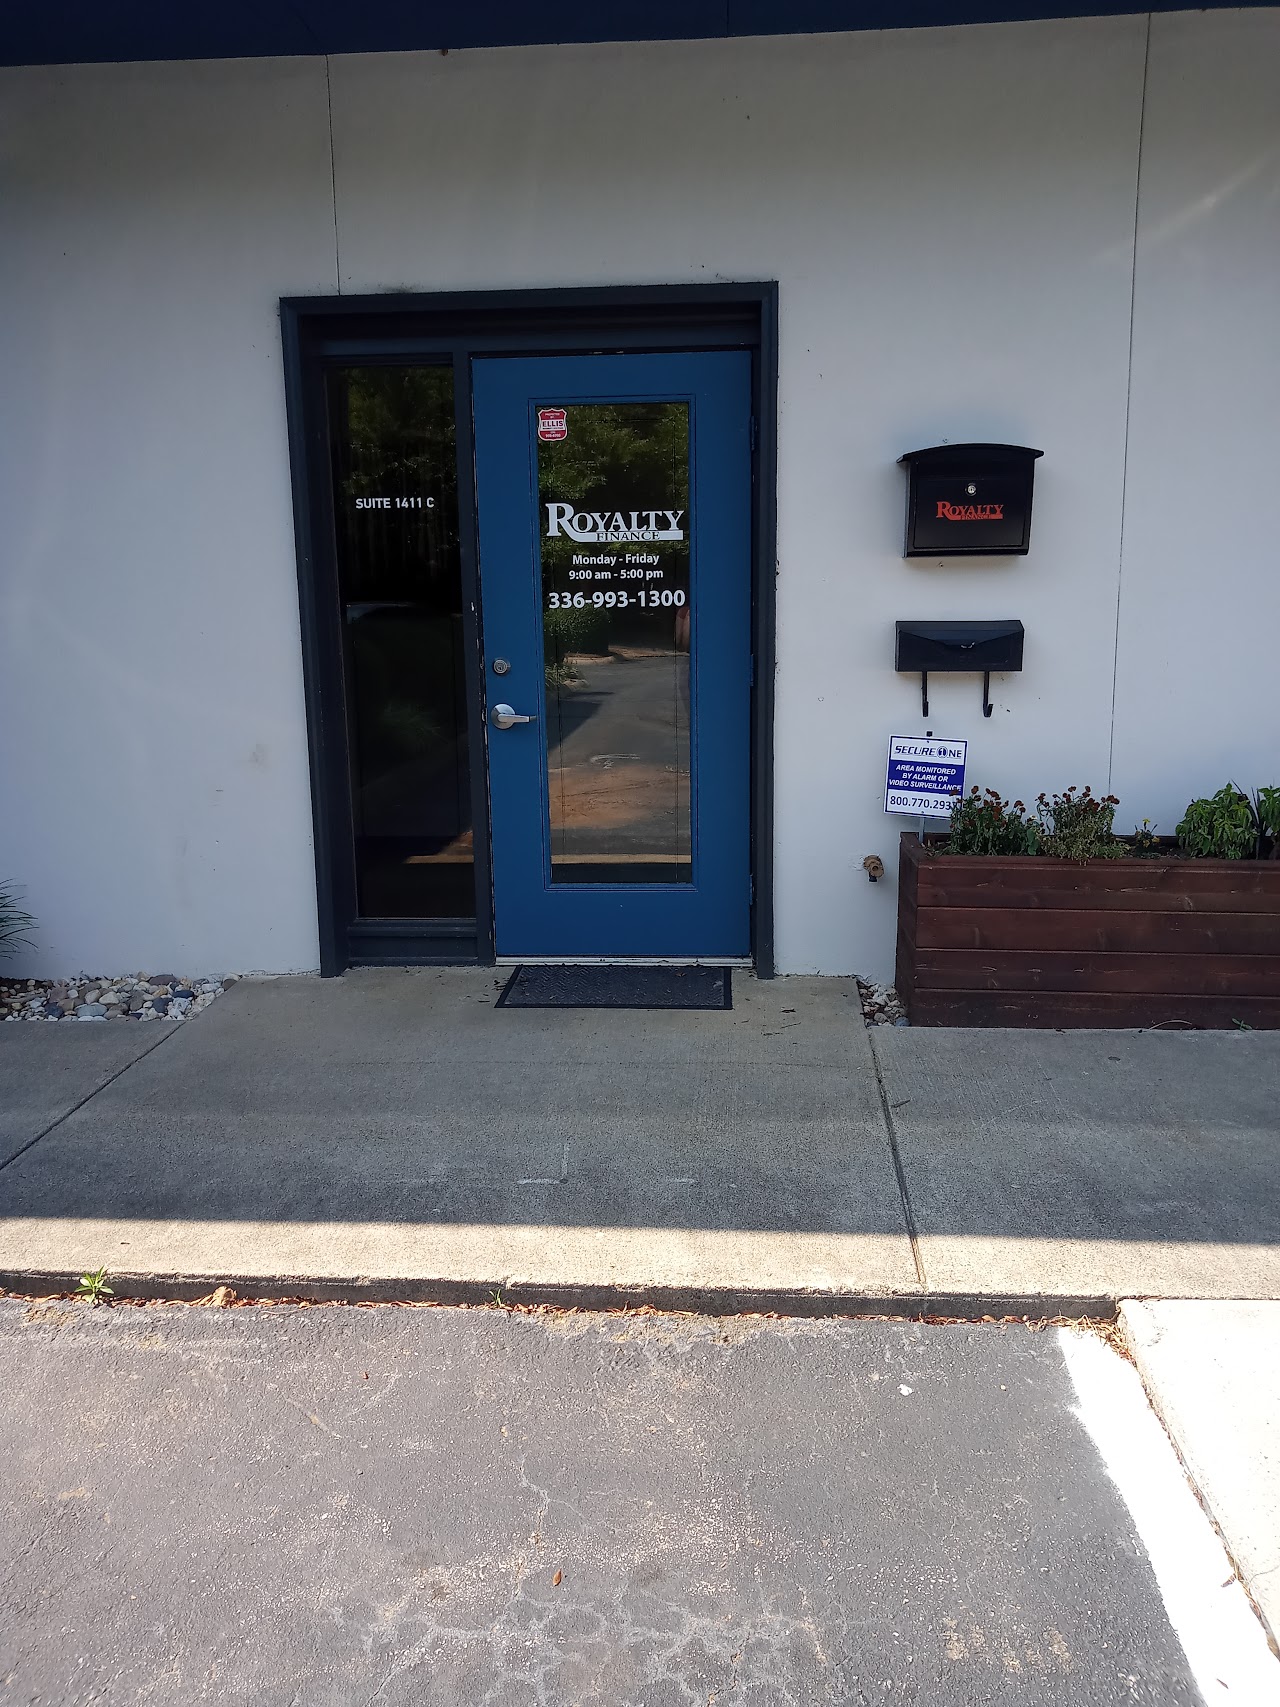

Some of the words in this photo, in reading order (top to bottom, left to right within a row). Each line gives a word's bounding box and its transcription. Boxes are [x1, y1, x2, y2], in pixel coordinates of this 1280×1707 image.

[355, 497, 391, 509] SUITE
[395, 497, 422, 509] 1411
[426, 497, 435, 508] C
[596, 531, 661, 541] FINANCE
[572, 554, 617, 566] Monday
[625, 553, 660, 565] Friday
[568, 570, 593, 580] 9:00
[594, 572, 612, 580] am
[620, 569, 644, 579] 5:00
[645, 569, 664, 580] pm
[548, 590, 686, 609] 336-993-1300
[894, 745, 936, 757] SECURE
[916, 766, 957, 775] MONITORED
[889, 779, 909, 787] VIDEO
